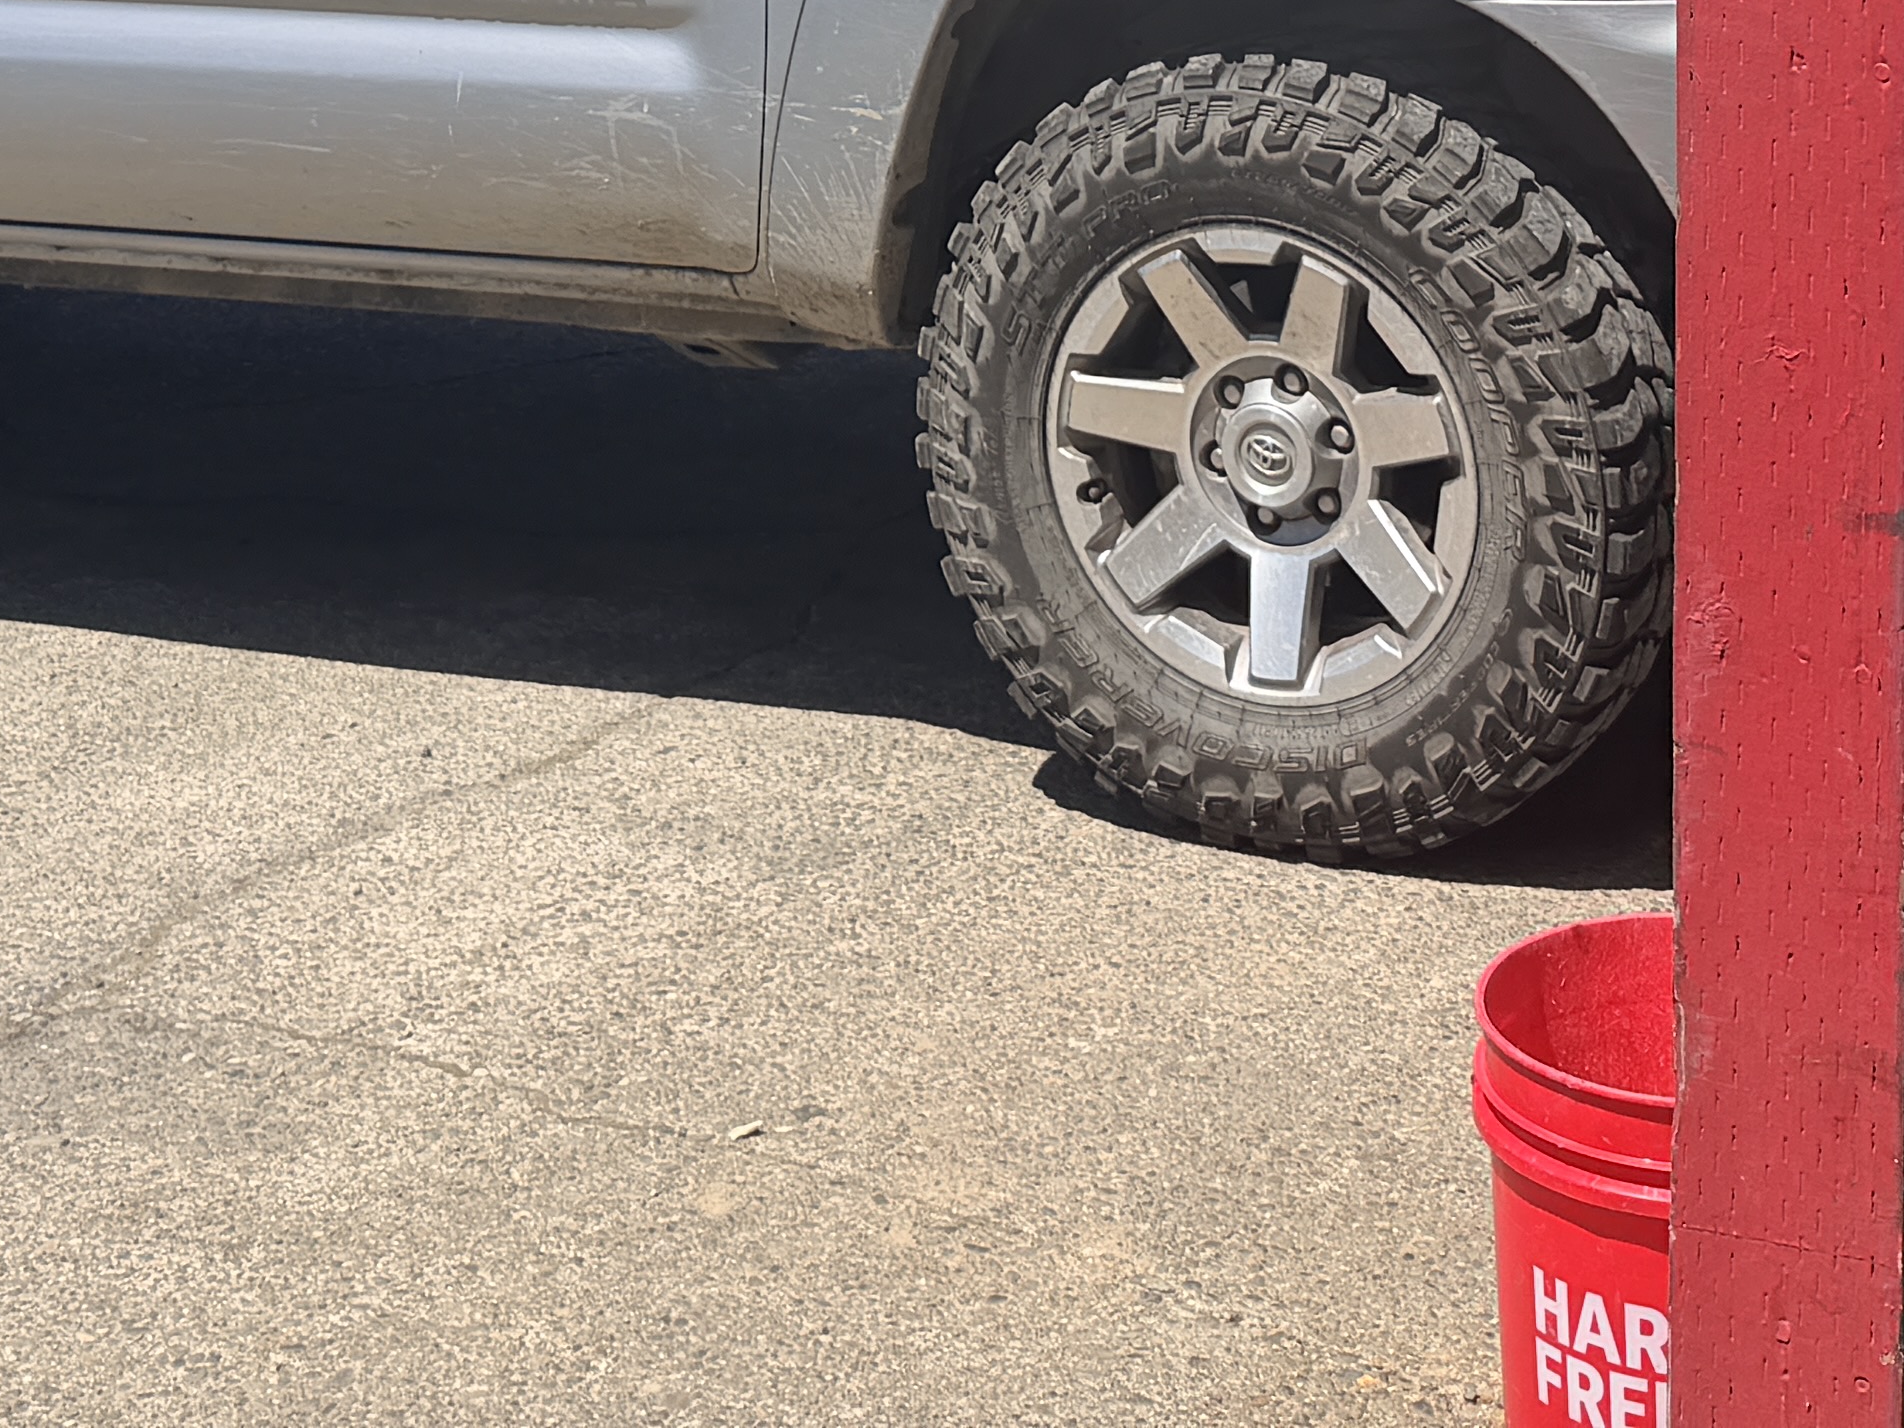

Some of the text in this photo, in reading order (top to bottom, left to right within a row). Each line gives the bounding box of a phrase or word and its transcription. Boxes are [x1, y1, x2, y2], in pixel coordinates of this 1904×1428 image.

[1082, 179, 1173, 239] PRO
[1407, 265, 1527, 562] COOPER
[1035, 592, 1369, 773] DISCOVERER
[1533, 1265, 1668, 1375] HAR
